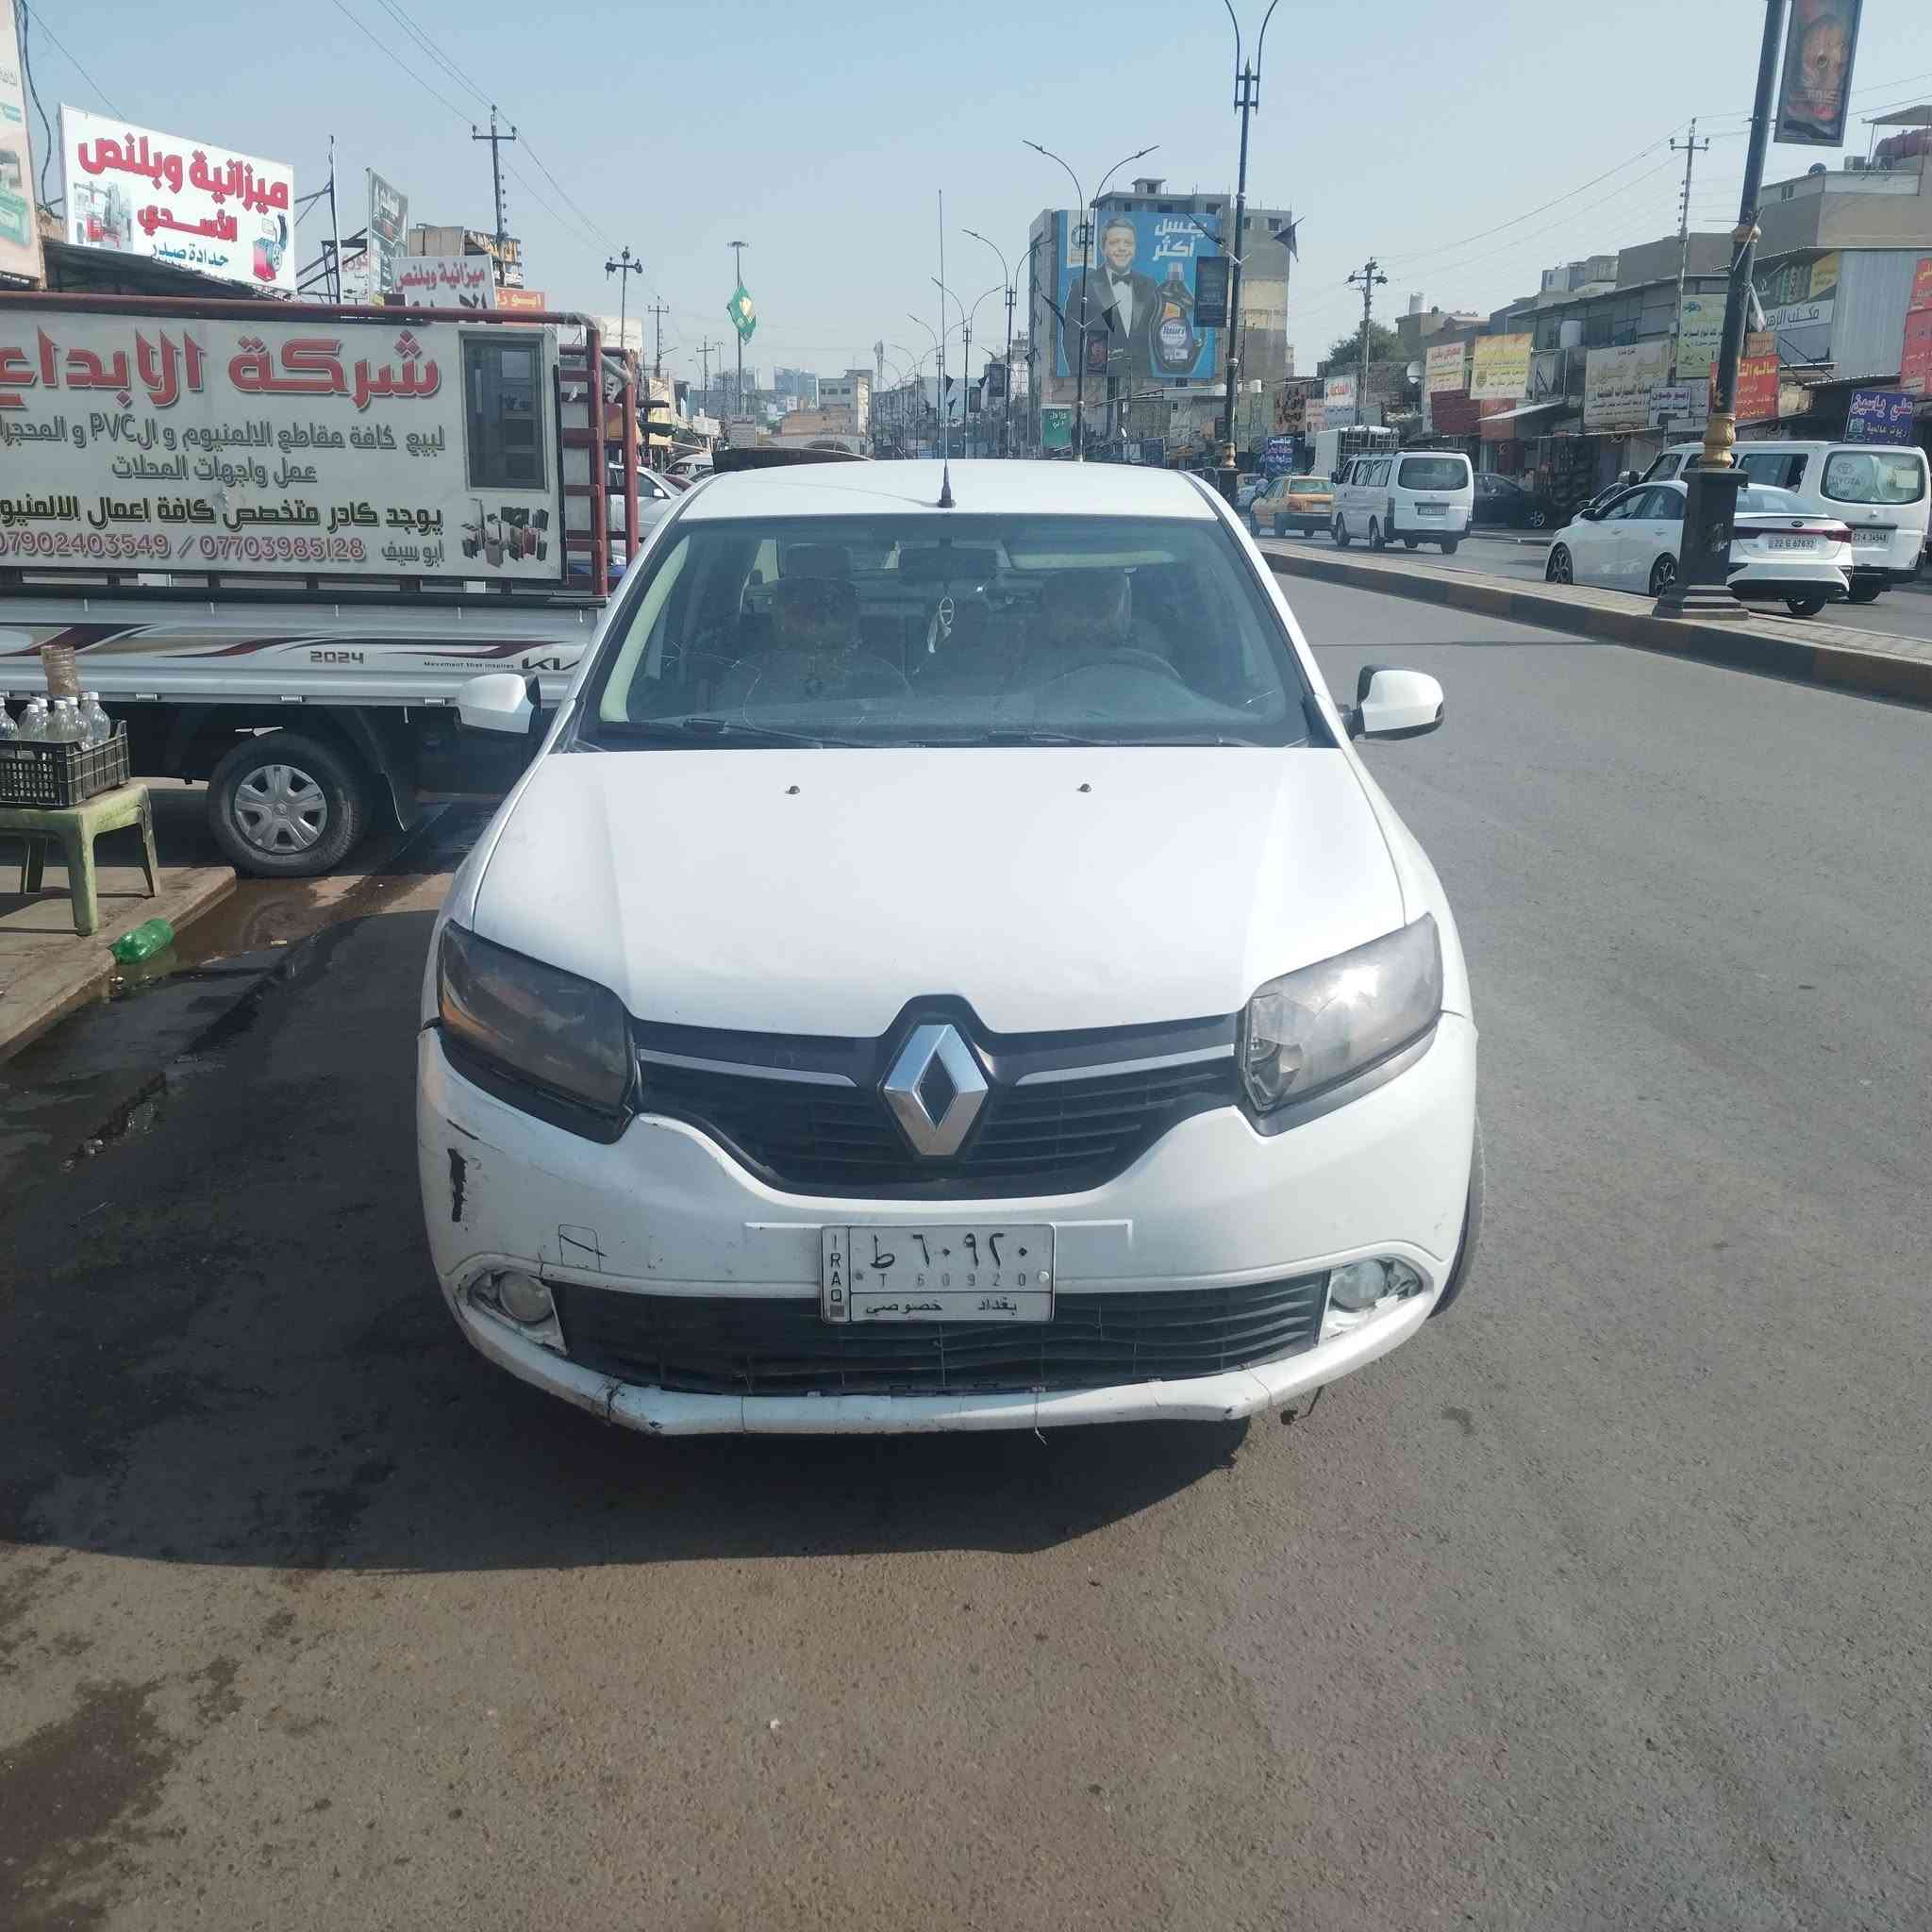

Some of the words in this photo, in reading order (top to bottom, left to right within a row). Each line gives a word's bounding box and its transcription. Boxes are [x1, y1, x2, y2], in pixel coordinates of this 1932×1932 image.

[78, 132, 183, 193] وبلنص
[189, 149, 289, 214] ميزانية
[189, 242, 229, 266] حدادة
[437, 261, 485, 291] ميزانية
[226, 332, 441, 409] شركة
[72, 424, 87, 448] و
[163, 426, 177, 450] و
[183, 421, 273, 452] الالمنيوم
[277, 422, 345, 453] مقاطع
[350, 425, 397, 449] كافة
[406, 425, 445, 457] لبيع
[111, 454, 189, 480] المحلات
[193, 456, 269, 488] واجهات
[274, 457, 318, 489] عمل
[88, 495, 151, 529] اعمال
[158, 495, 216, 524] كافة
[223, 499, 321, 533] متخصص
[327, 501, 380, 534] كادر
[386, 507, 444, 536] يوجد
[200, 535, 366, 562] 07703985128
[381, 541, 420, 566] سيف
[309, 650, 364, 664] 2024
[870, 1234, 895, 1269] ط
[829, 1234, 842, 1303] IRAQ
[977, 1296, 1018, 1316] بغداد
